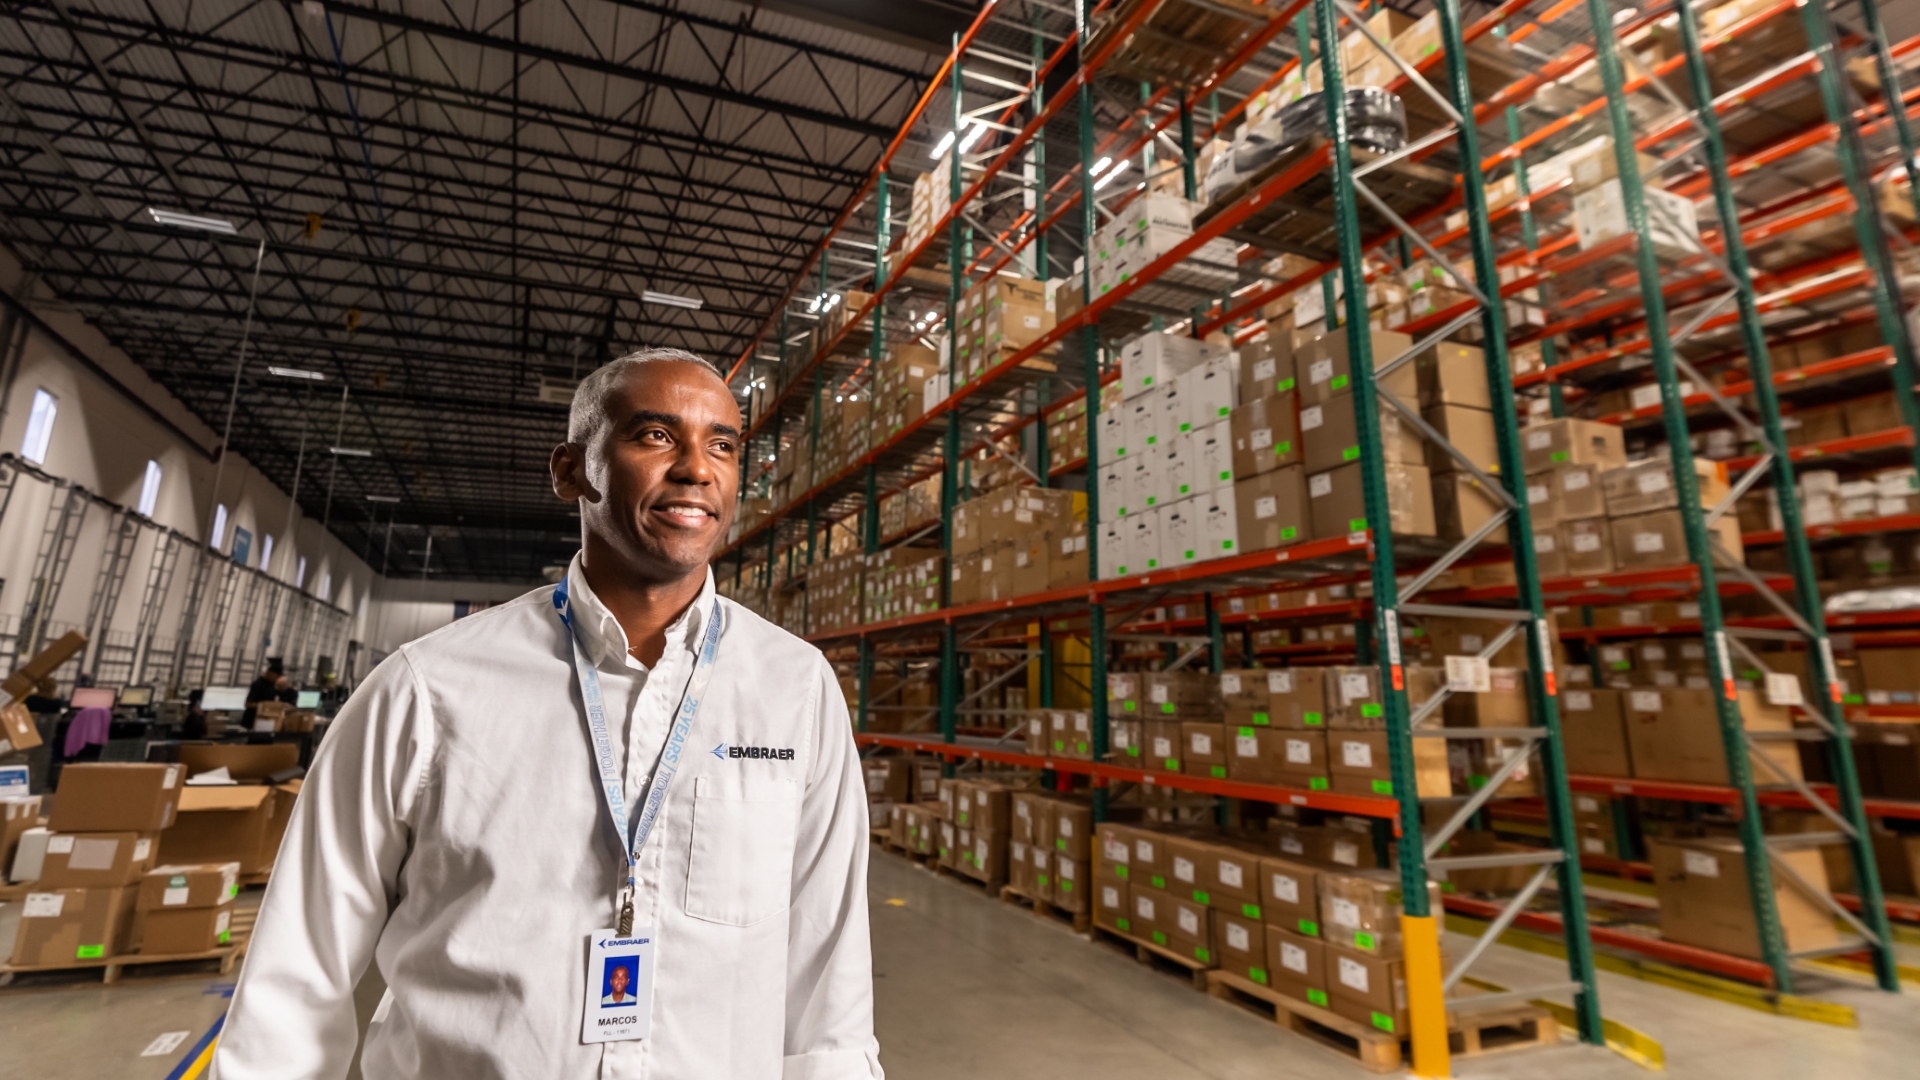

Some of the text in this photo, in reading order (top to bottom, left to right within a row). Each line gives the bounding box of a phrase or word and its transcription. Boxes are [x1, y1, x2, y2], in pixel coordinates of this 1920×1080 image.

[683, 695, 699, 716] 25
[589, 705, 615, 776] TOGETHER
[664, 716, 692, 763] YEARS
[729, 746, 795, 760] EMBRAER
[607, 785, 628, 836] YEARS
[636, 770, 671, 844] TOGETHER
[608, 938, 650, 946] EMBRAER
[598, 1016, 637, 1026] MARCOS
